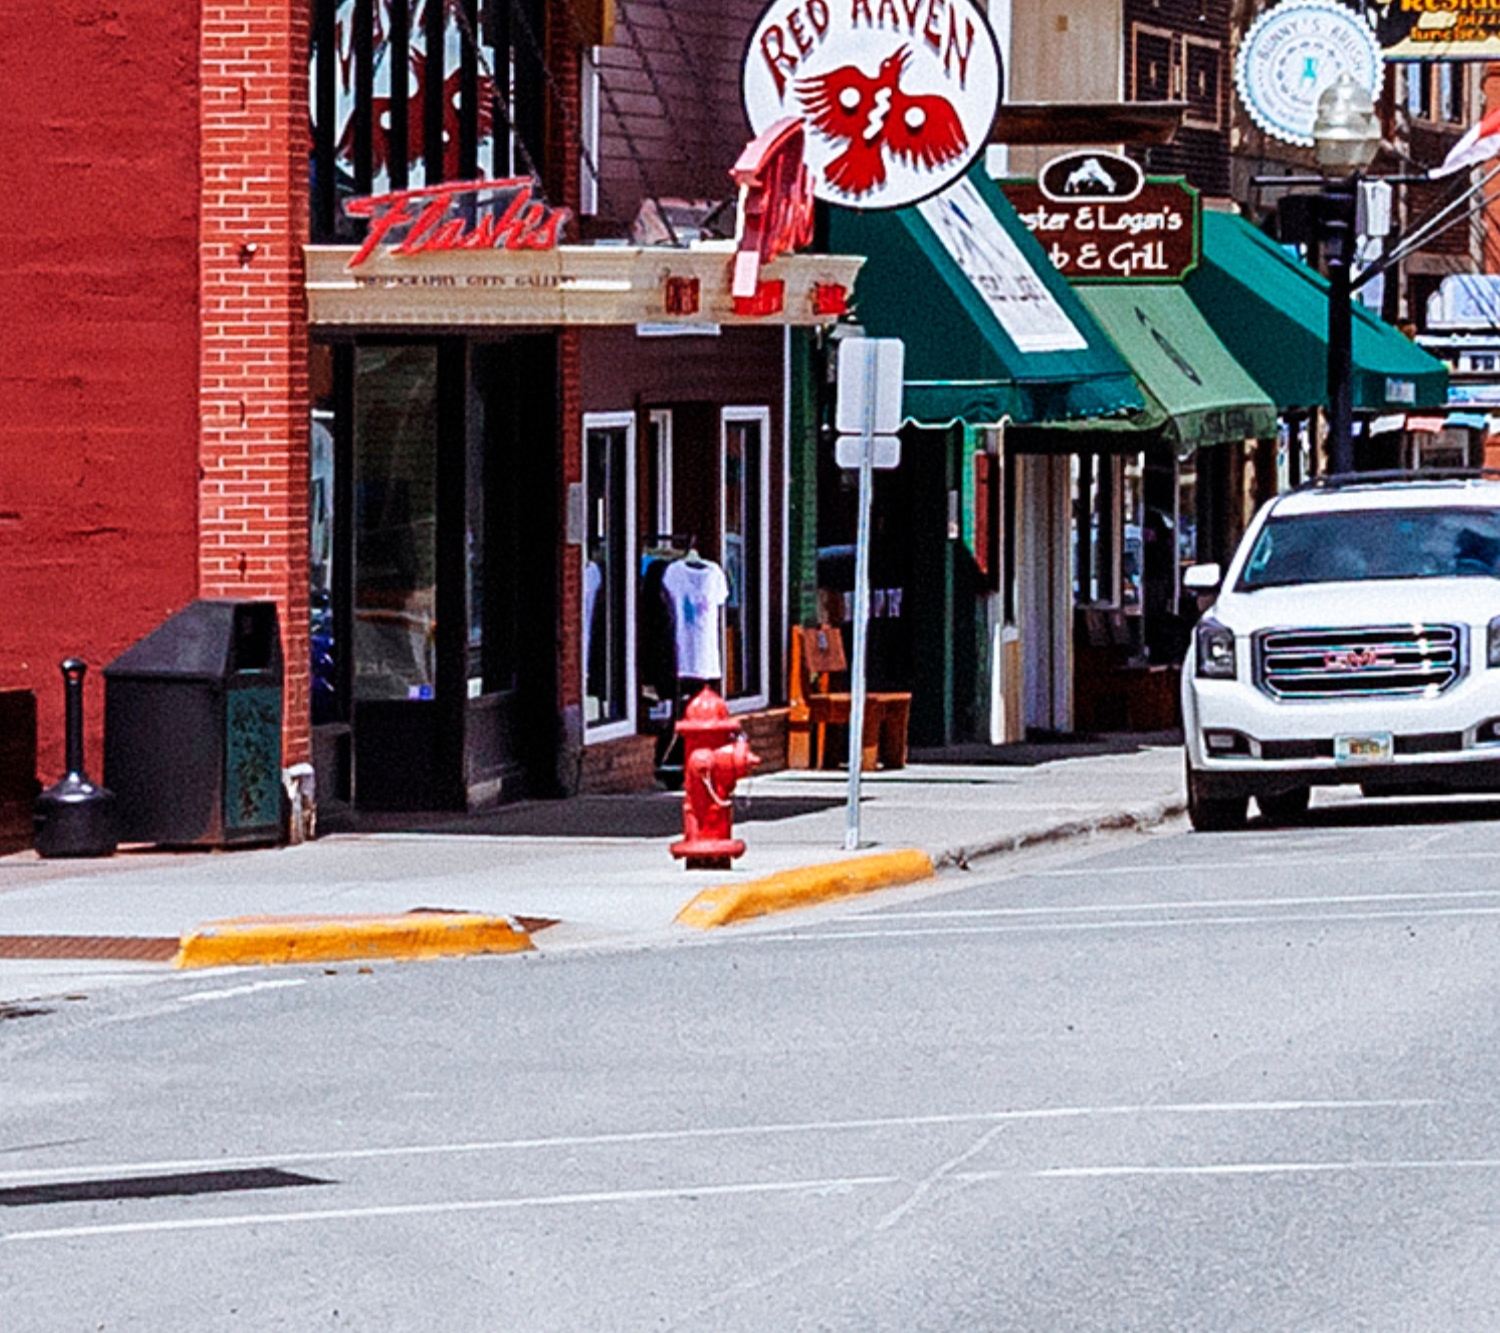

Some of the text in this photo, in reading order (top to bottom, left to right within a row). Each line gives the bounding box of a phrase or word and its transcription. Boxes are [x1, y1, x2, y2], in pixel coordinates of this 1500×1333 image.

[1018, 205, 1070, 231] ster
[1098, 205, 1183, 235] Logan's
[1076, 243, 1101, 270] &
[1108, 241, 1169, 276] Grill
